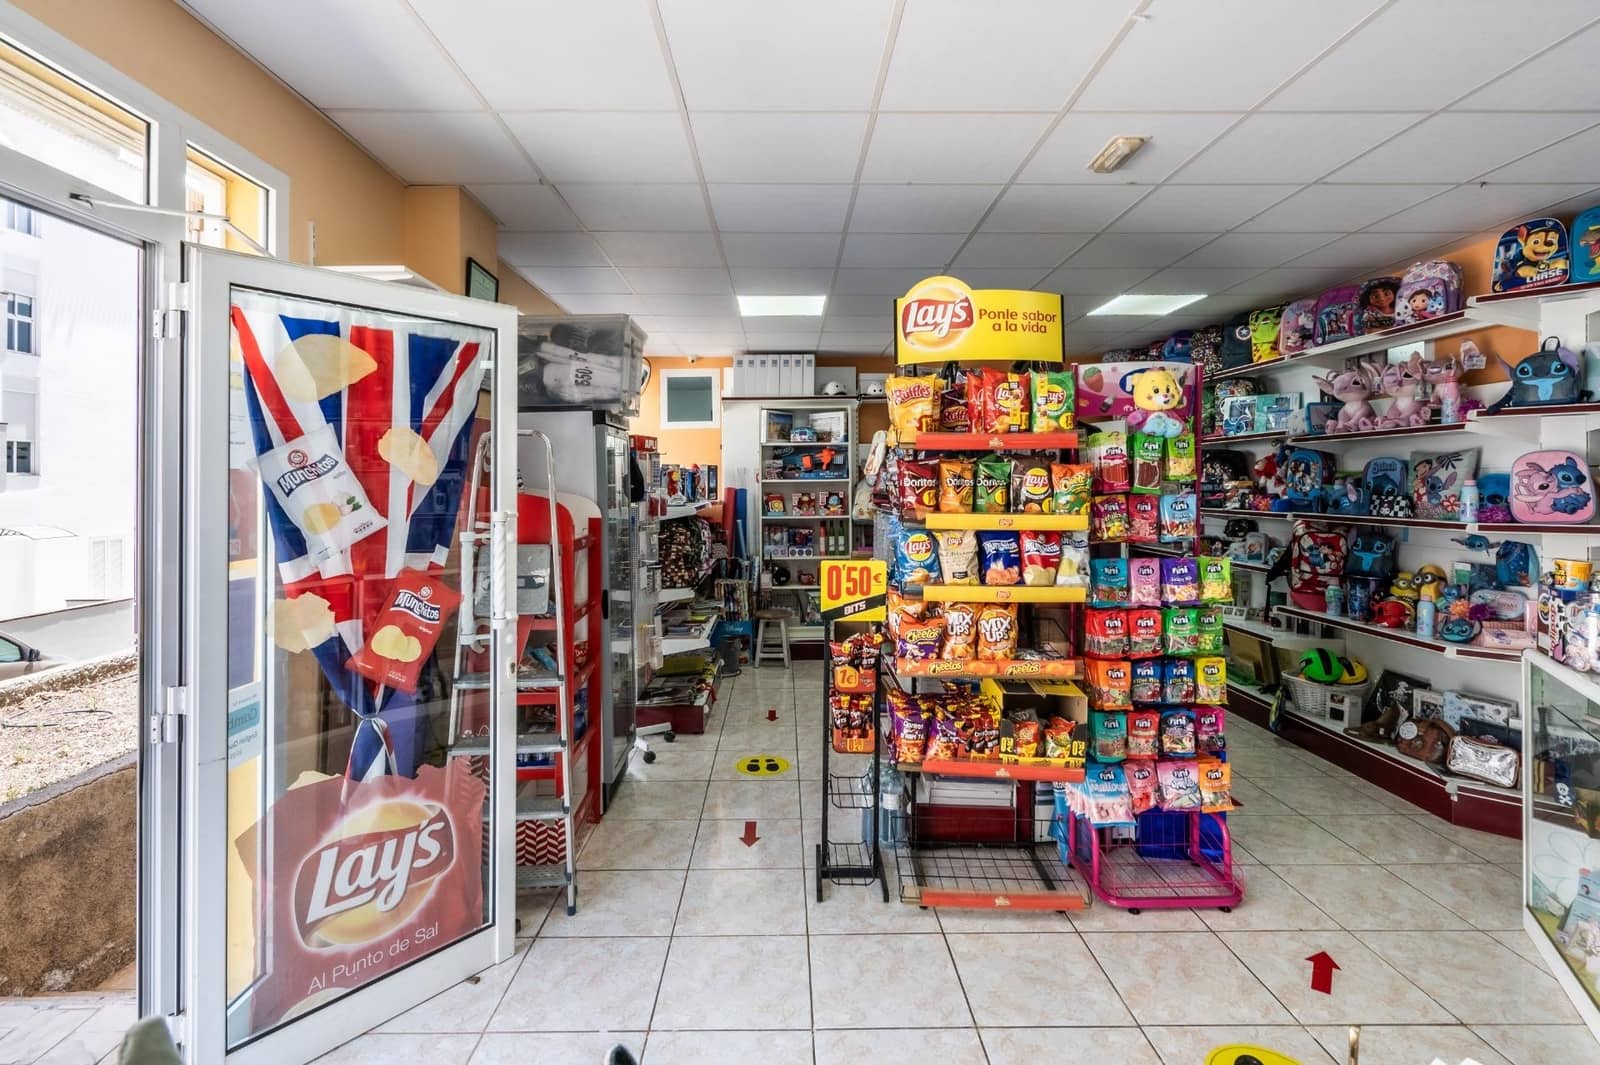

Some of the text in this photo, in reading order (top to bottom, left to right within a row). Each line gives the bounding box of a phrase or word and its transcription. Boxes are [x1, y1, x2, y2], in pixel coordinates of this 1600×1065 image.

[906, 298, 970, 338] Lay's
[978, 308, 1057, 323] Ponle sabor
[992, 319, 1047, 334] a la vida
[893, 385, 931, 405] Ruffles
[279, 457, 337, 494] Munchitos
[903, 478, 936, 487] Doritos
[946, 478, 973, 487] Doritos
[395, 592, 439, 619] Munchitos
[844, 600, 866, 615] BITS
[905, 628, 941, 642] Cheetos
[928, 662, 963, 675] Cheetos
[1005, 662, 1041, 676] Cheetos
[306, 820, 445, 924] Lay's
[307, 921, 439, 995] Al Punto de Sal
